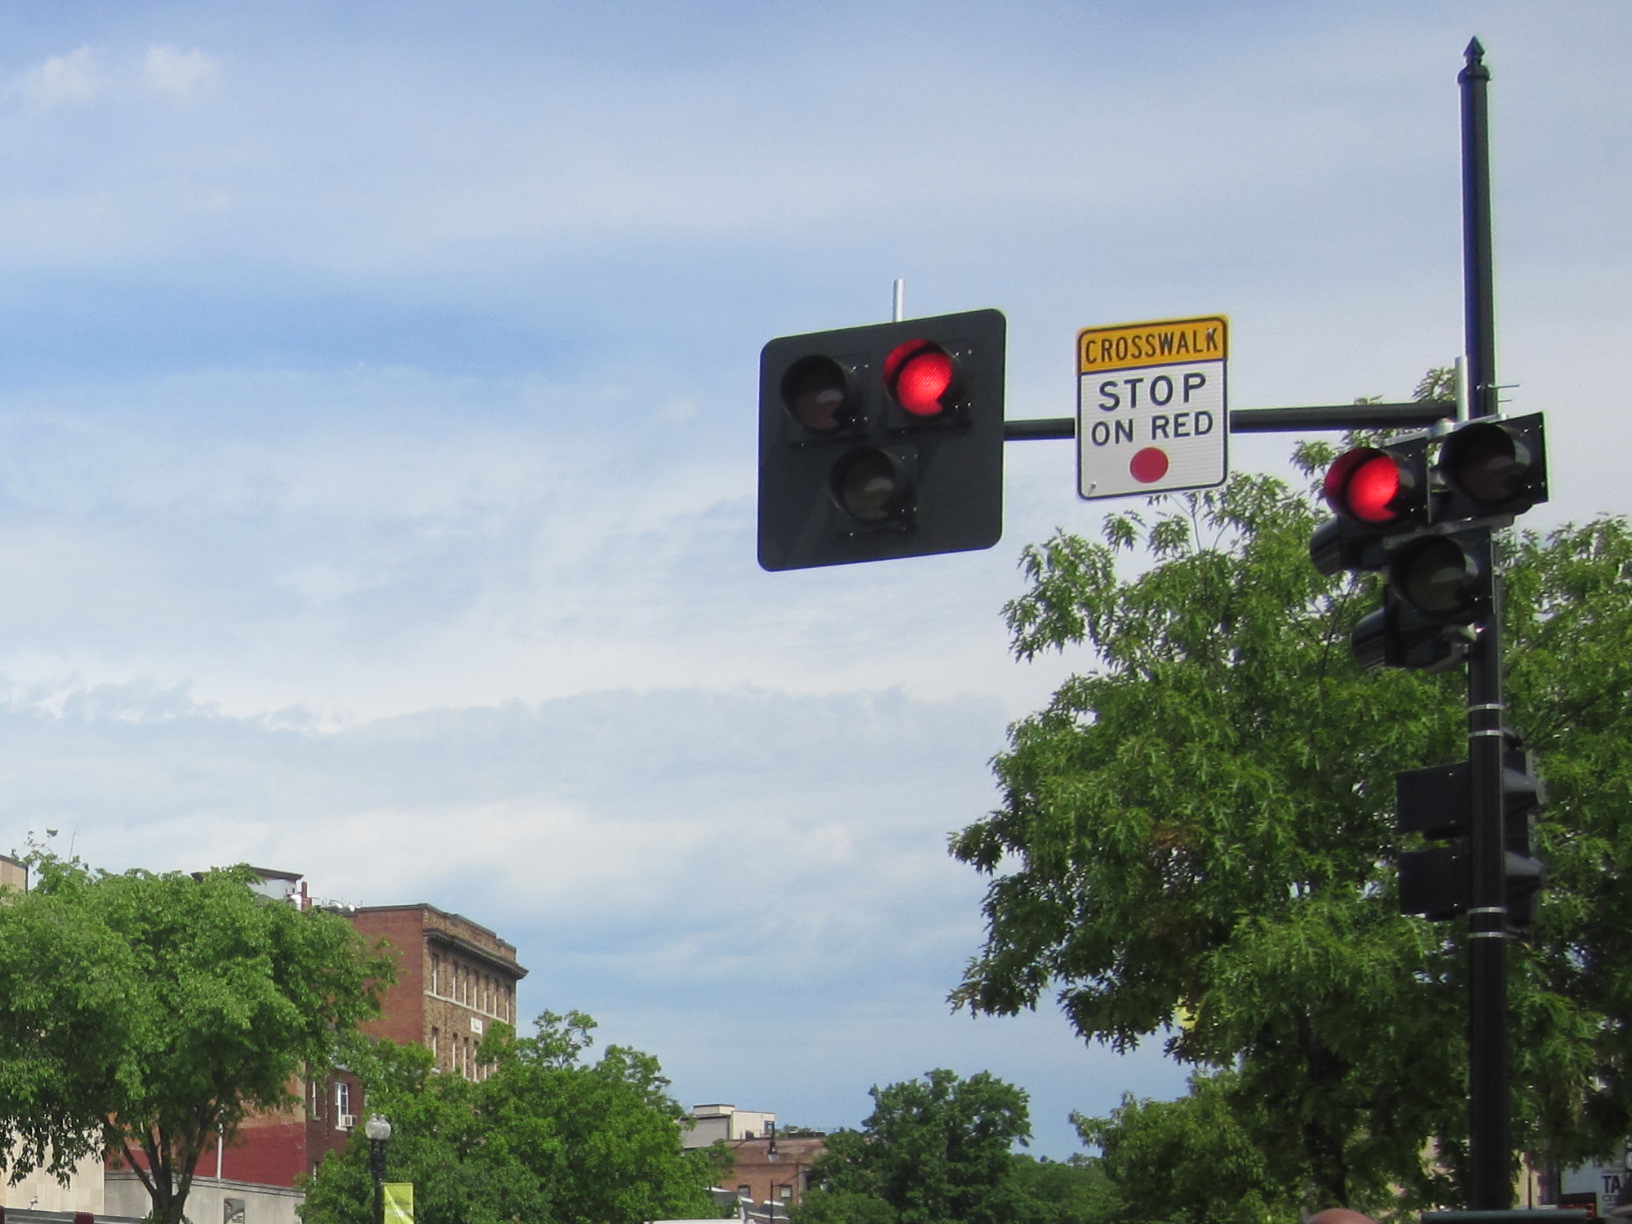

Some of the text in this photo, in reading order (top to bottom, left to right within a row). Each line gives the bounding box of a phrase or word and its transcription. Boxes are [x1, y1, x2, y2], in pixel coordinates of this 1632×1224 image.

[1085, 327, 1219, 364] CROSSWALK
[1098, 372, 1207, 412] STOP
[1091, 410, 1214, 447] ON RED
